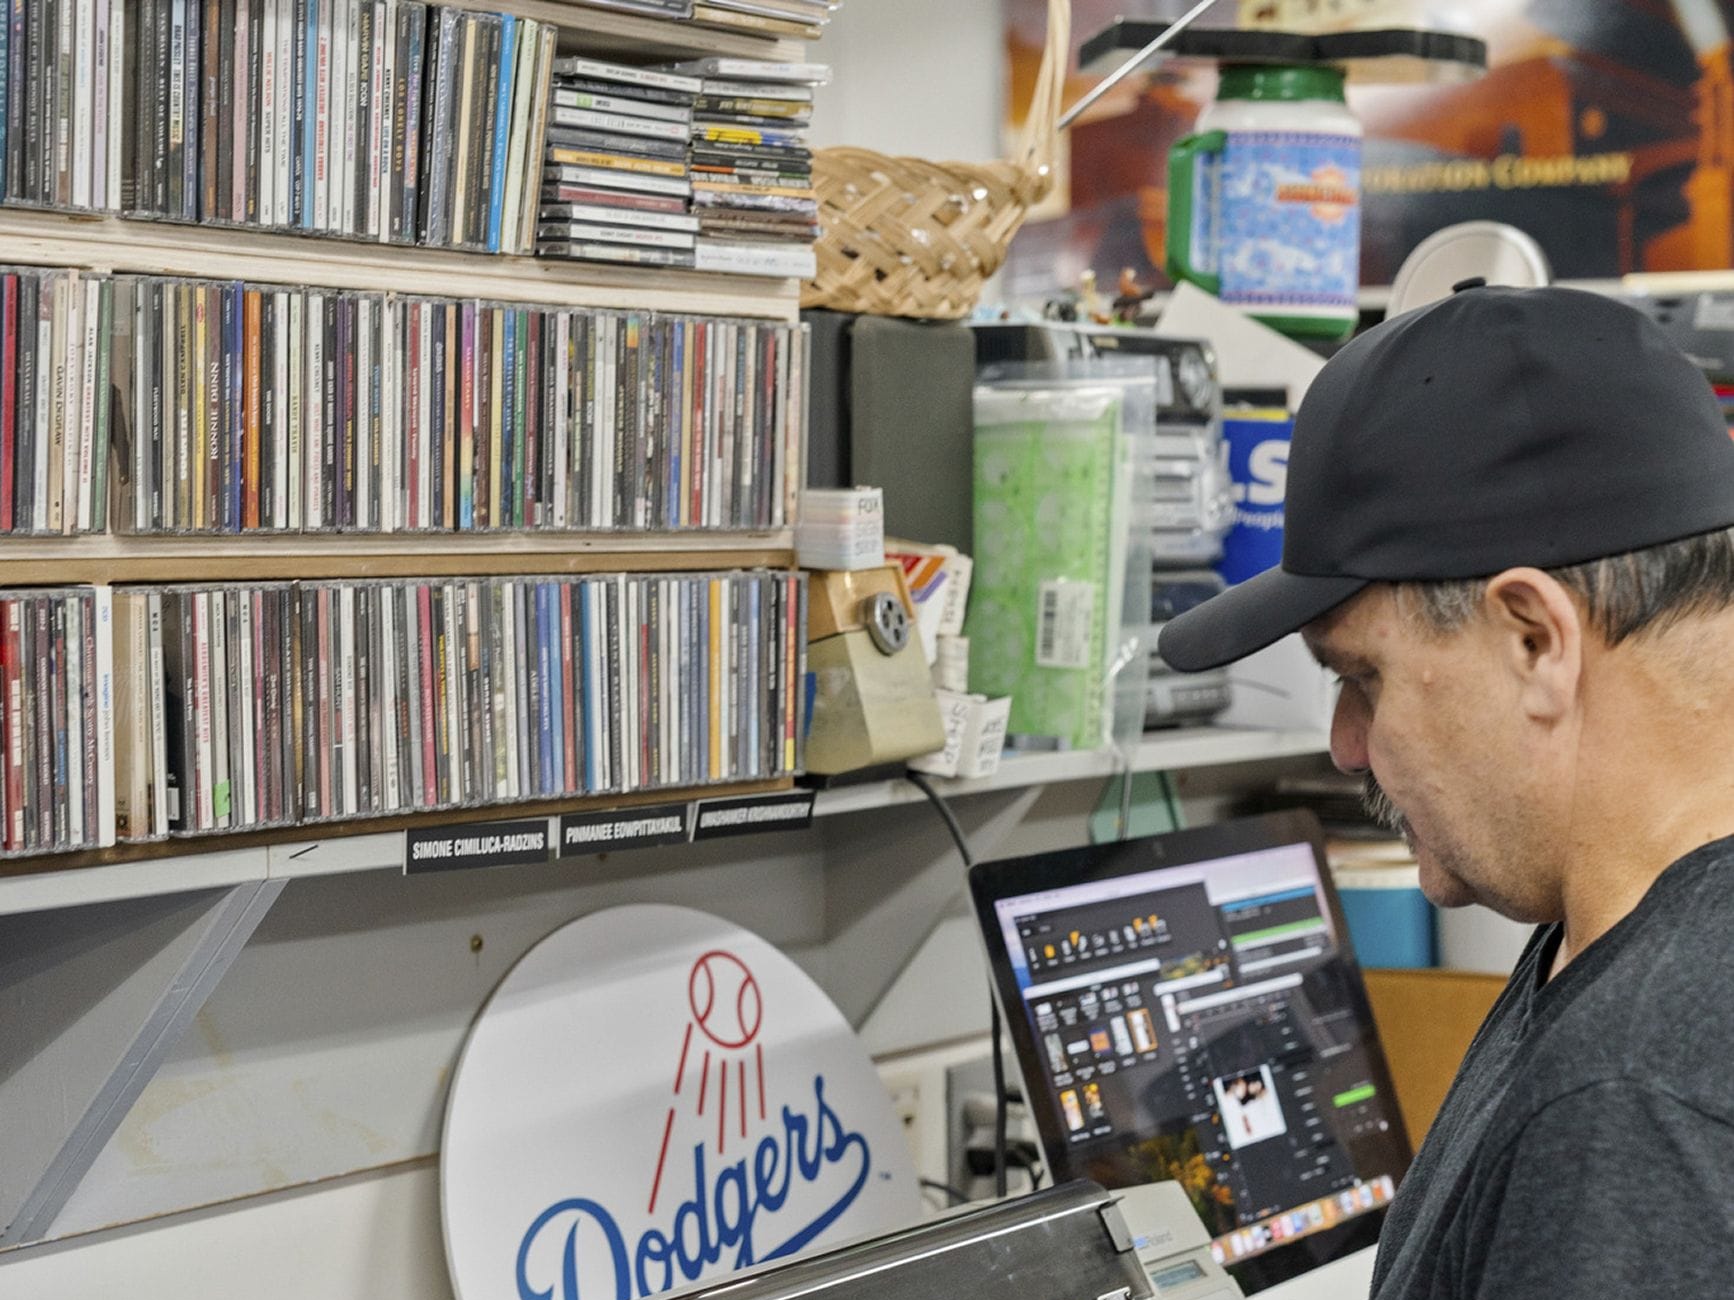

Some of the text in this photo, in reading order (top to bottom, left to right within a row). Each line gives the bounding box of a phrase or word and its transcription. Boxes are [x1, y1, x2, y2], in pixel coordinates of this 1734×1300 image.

[359, 13, 370, 107] MARVIN GAYE ICON
[396, 103, 404, 139] LONELY
[1492, 153, 1630, 190] COMPANY
[55, 366, 64, 398] GAVIN
[84, 387, 92, 424] GREATEST
[211, 362, 219, 459] RONNIE DUNN
[586, 401, 594, 424] ICON
[617, 385, 625, 428] JUSTIN
[85, 637, 94, 689] Christmas
[612, 625, 621, 721] CLINT BLACK
[531, 670, 539, 699] ADELE
[86, 708, 95, 737] Scotty
[202, 727, 210, 743] HITS
[86, 739, 95, 785] McCreery
[412, 832, 544, 860] SIMONE CIMILUCA-RADZINS
